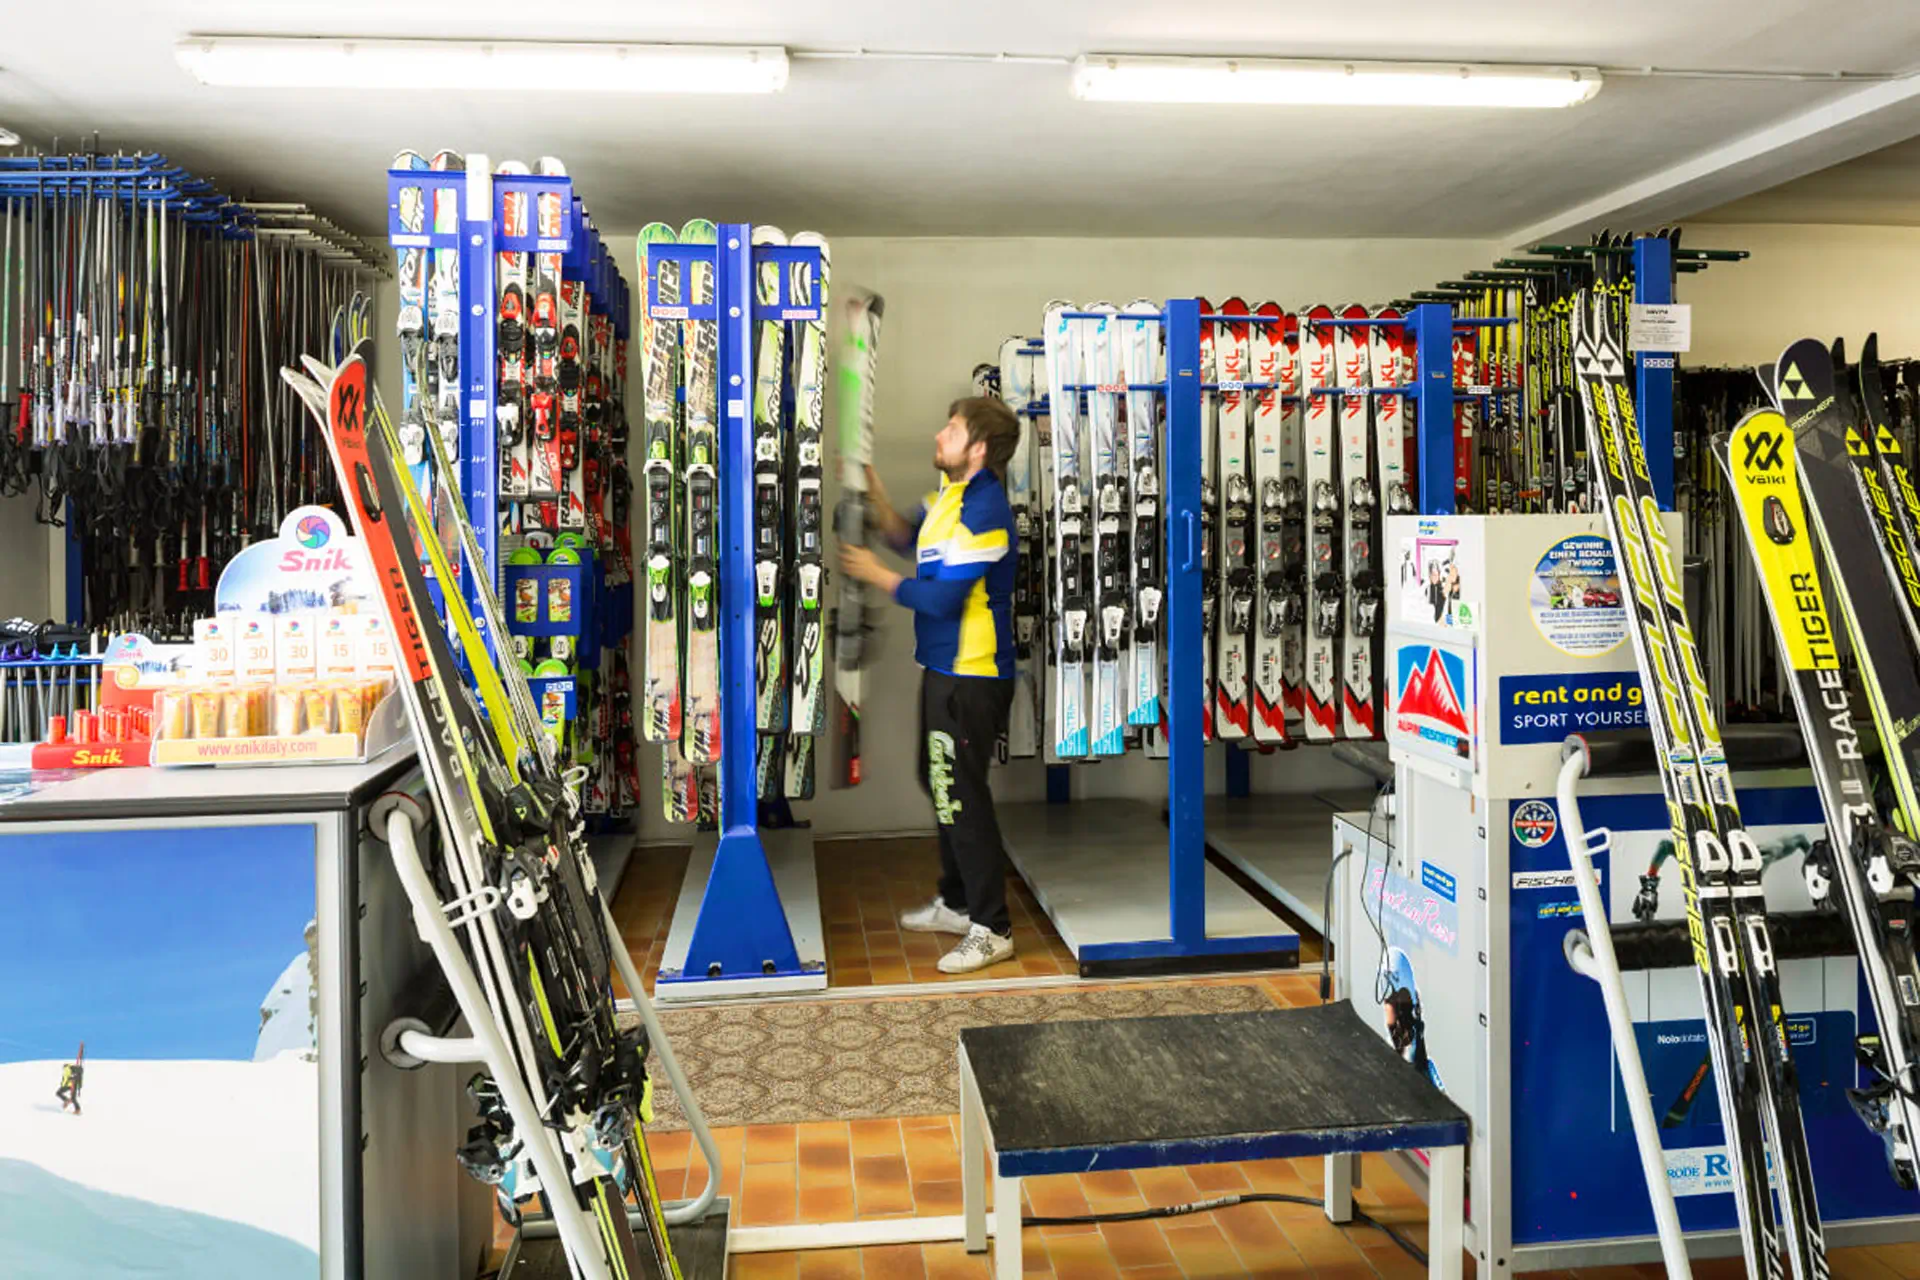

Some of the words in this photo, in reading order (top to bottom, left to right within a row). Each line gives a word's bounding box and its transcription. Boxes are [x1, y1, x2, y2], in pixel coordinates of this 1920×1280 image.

[1592, 381, 1624, 482] FISCHER
[1615, 382, 1650, 482] FISCHER
[281, 549, 354, 572] Snik
[1579, 549, 1614, 558] RENAUL
[209, 648, 228, 662] 30
[250, 646, 268, 660] 30
[290, 645, 308, 659] 30
[332, 644, 349, 657] 15
[372, 642, 388, 656] 15
[1513, 686, 1569, 705] rent
[1573, 683, 1622, 702] and
[1627, 687, 1643, 706] g
[1513, 713, 1569, 729] SPORT
[1575, 710, 1649, 726] YOURSE
[197, 740, 317, 756] www.snikitaly.com
[72, 748, 124, 764] Snik
[1516, 876, 1576, 887] FISCHE
[1667, 800, 1710, 976] FISCHER
[1666, 1166, 1700, 1179] RODE
